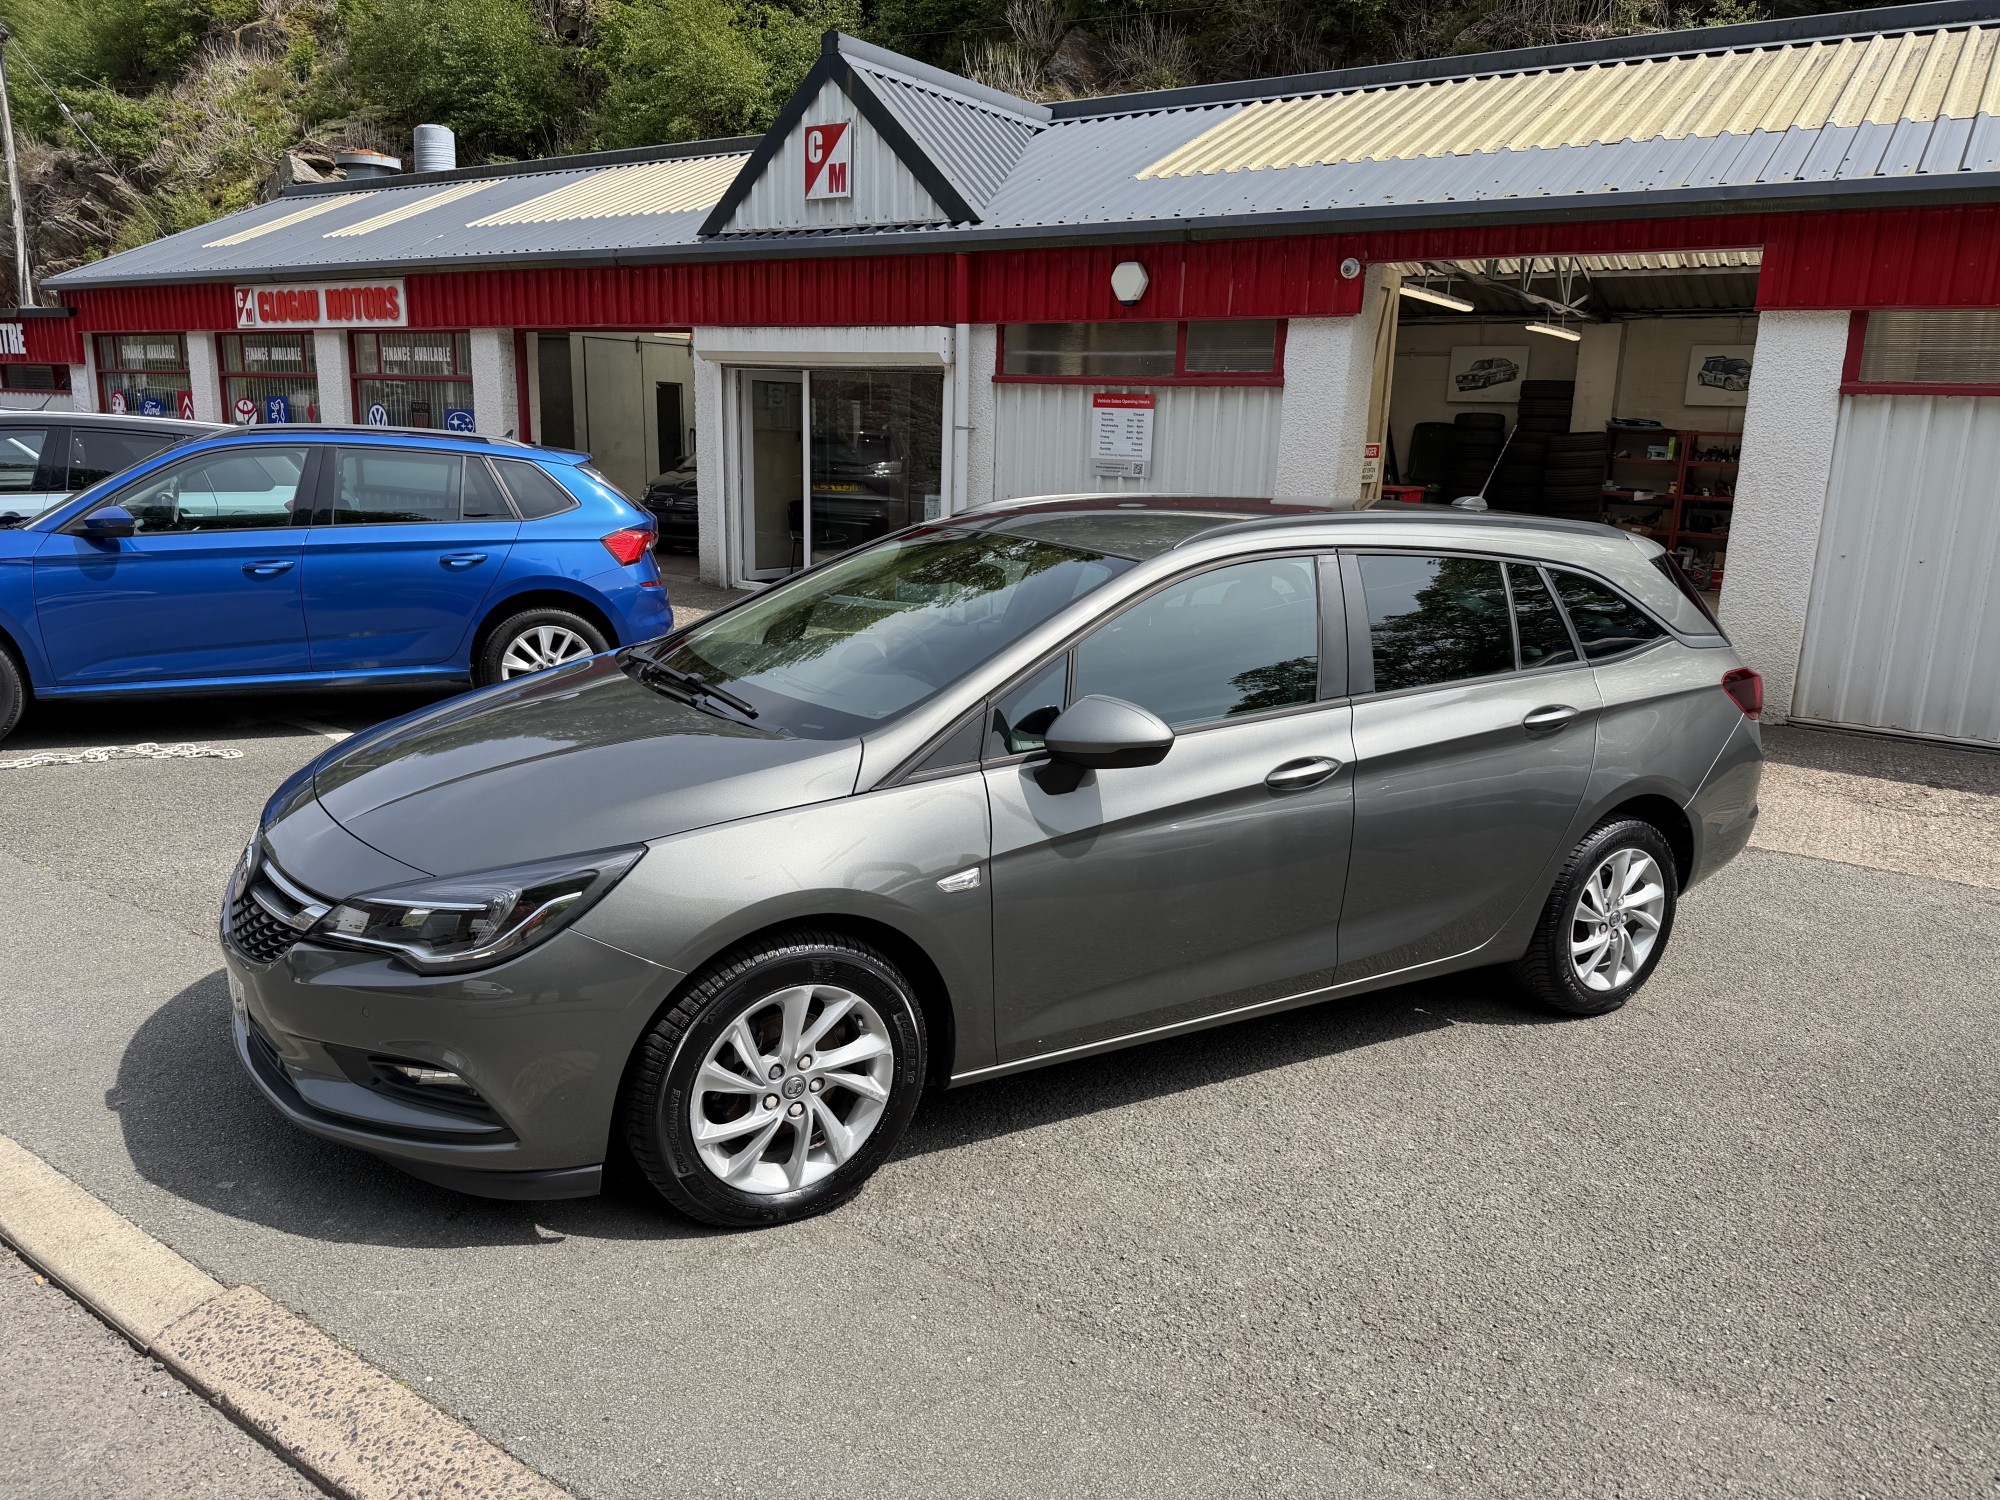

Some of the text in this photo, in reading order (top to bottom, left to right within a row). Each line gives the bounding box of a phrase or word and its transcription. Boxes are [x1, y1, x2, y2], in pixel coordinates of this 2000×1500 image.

[808, 130, 823, 164] C
[828, 162, 847, 193] M
[237, 291, 244, 308] C
[257, 286, 400, 322] CLOGAU MOTORS
[245, 307, 253, 323] M
[0, 323, 27, 354] TRE
[122, 344, 176, 359] FINANCE AVAILABLE
[245, 347, 302, 360] FINANCE AVAILABLE
[383, 346, 451, 361] FINANCE AVAILABLE
[143, 400, 161, 416] Ford
[1366, 447, 1377, 456] NGER
